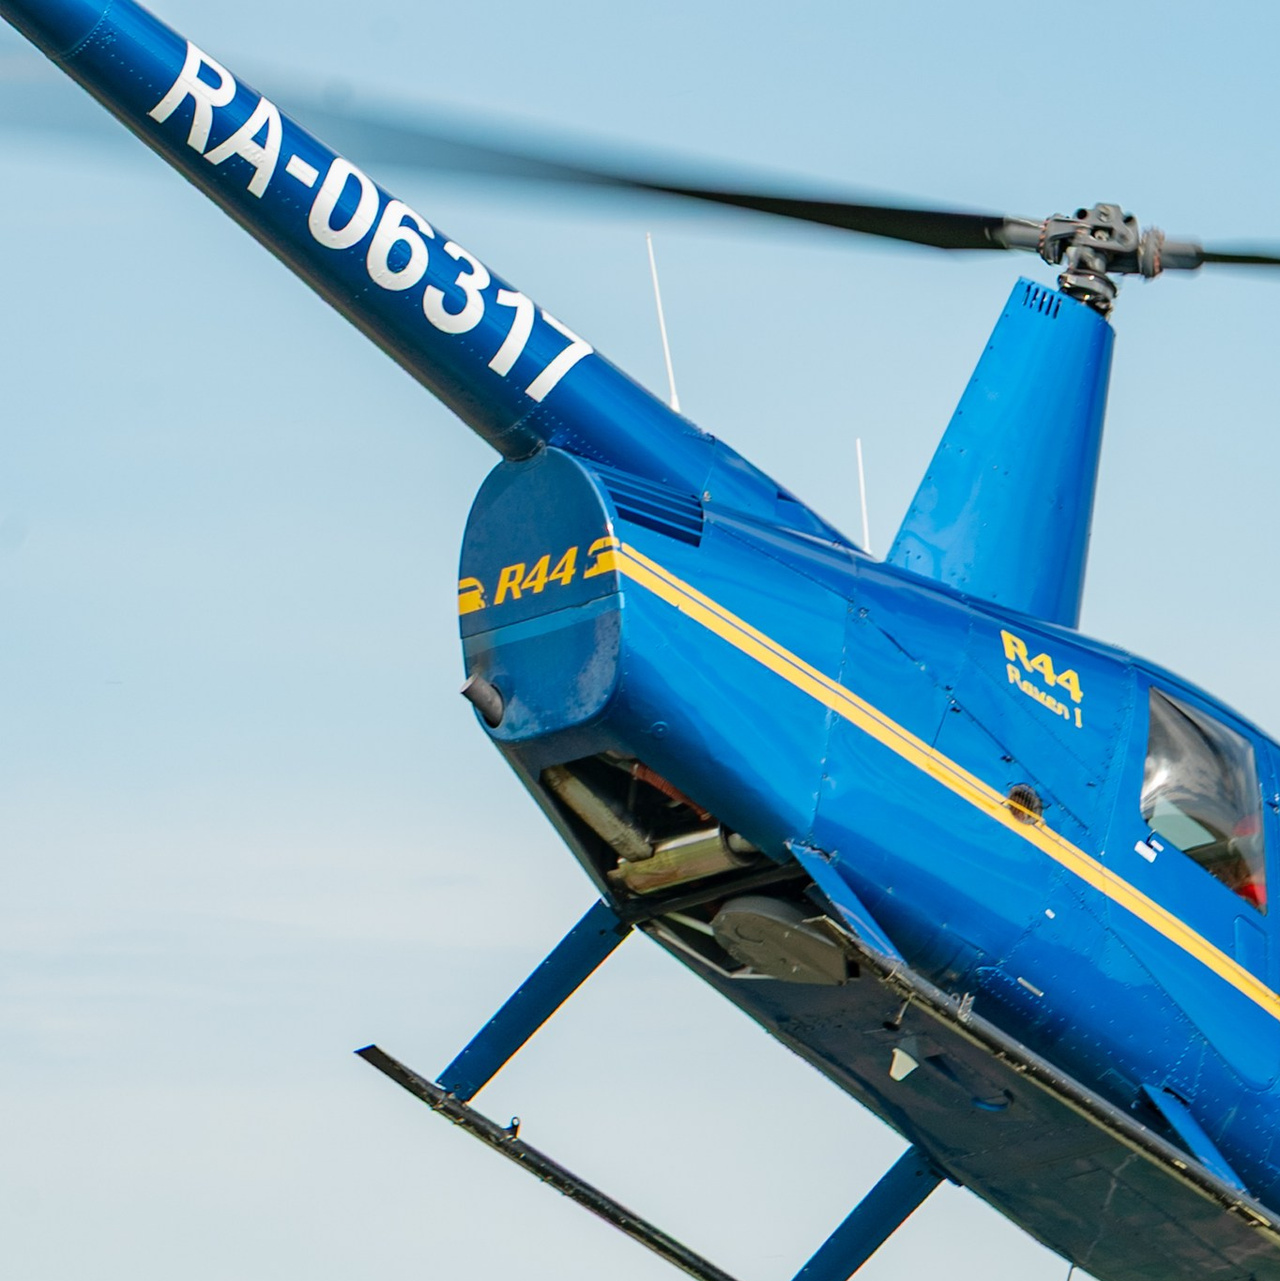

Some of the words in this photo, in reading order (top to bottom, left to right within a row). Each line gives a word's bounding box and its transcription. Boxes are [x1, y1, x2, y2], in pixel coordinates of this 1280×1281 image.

[147, 40, 594, 404] RA-06317
[493, 545, 579, 606] R44
[1001, 630, 1083, 703] R44
[1007, 664, 1070, 719] Raven
